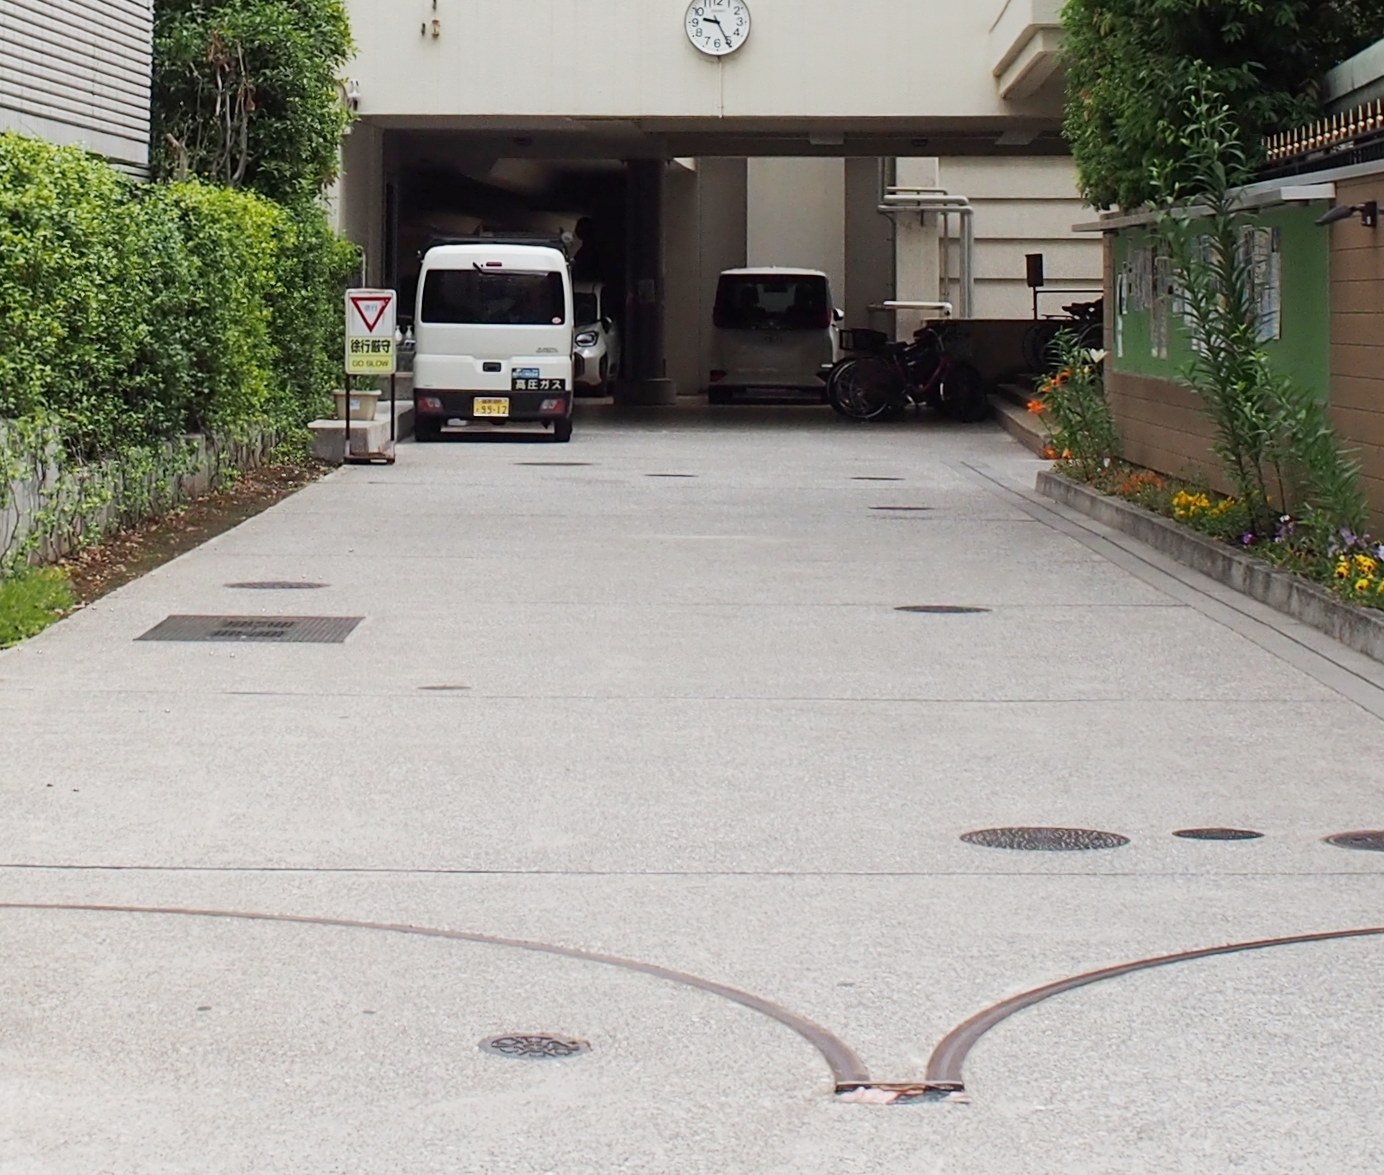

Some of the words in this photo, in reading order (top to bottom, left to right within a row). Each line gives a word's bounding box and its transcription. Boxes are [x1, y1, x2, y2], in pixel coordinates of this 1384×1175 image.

[694, 7, 704, 16] 10
[733, 6, 740, 15] 2
[691, 18, 699, 27] 9
[736, 17, 743, 26] 3
[696, 28, 703, 37] 8
[733, 28, 740, 36] 4
[704, 36, 711, 45] 7
[713, 38, 721, 48] 6
[350, 338, 391, 354] 徐行厳守
[352, 359, 364, 367] GO
[366, 359, 389, 367] SLOW
[515, 379, 562, 390] 高圧ガス
